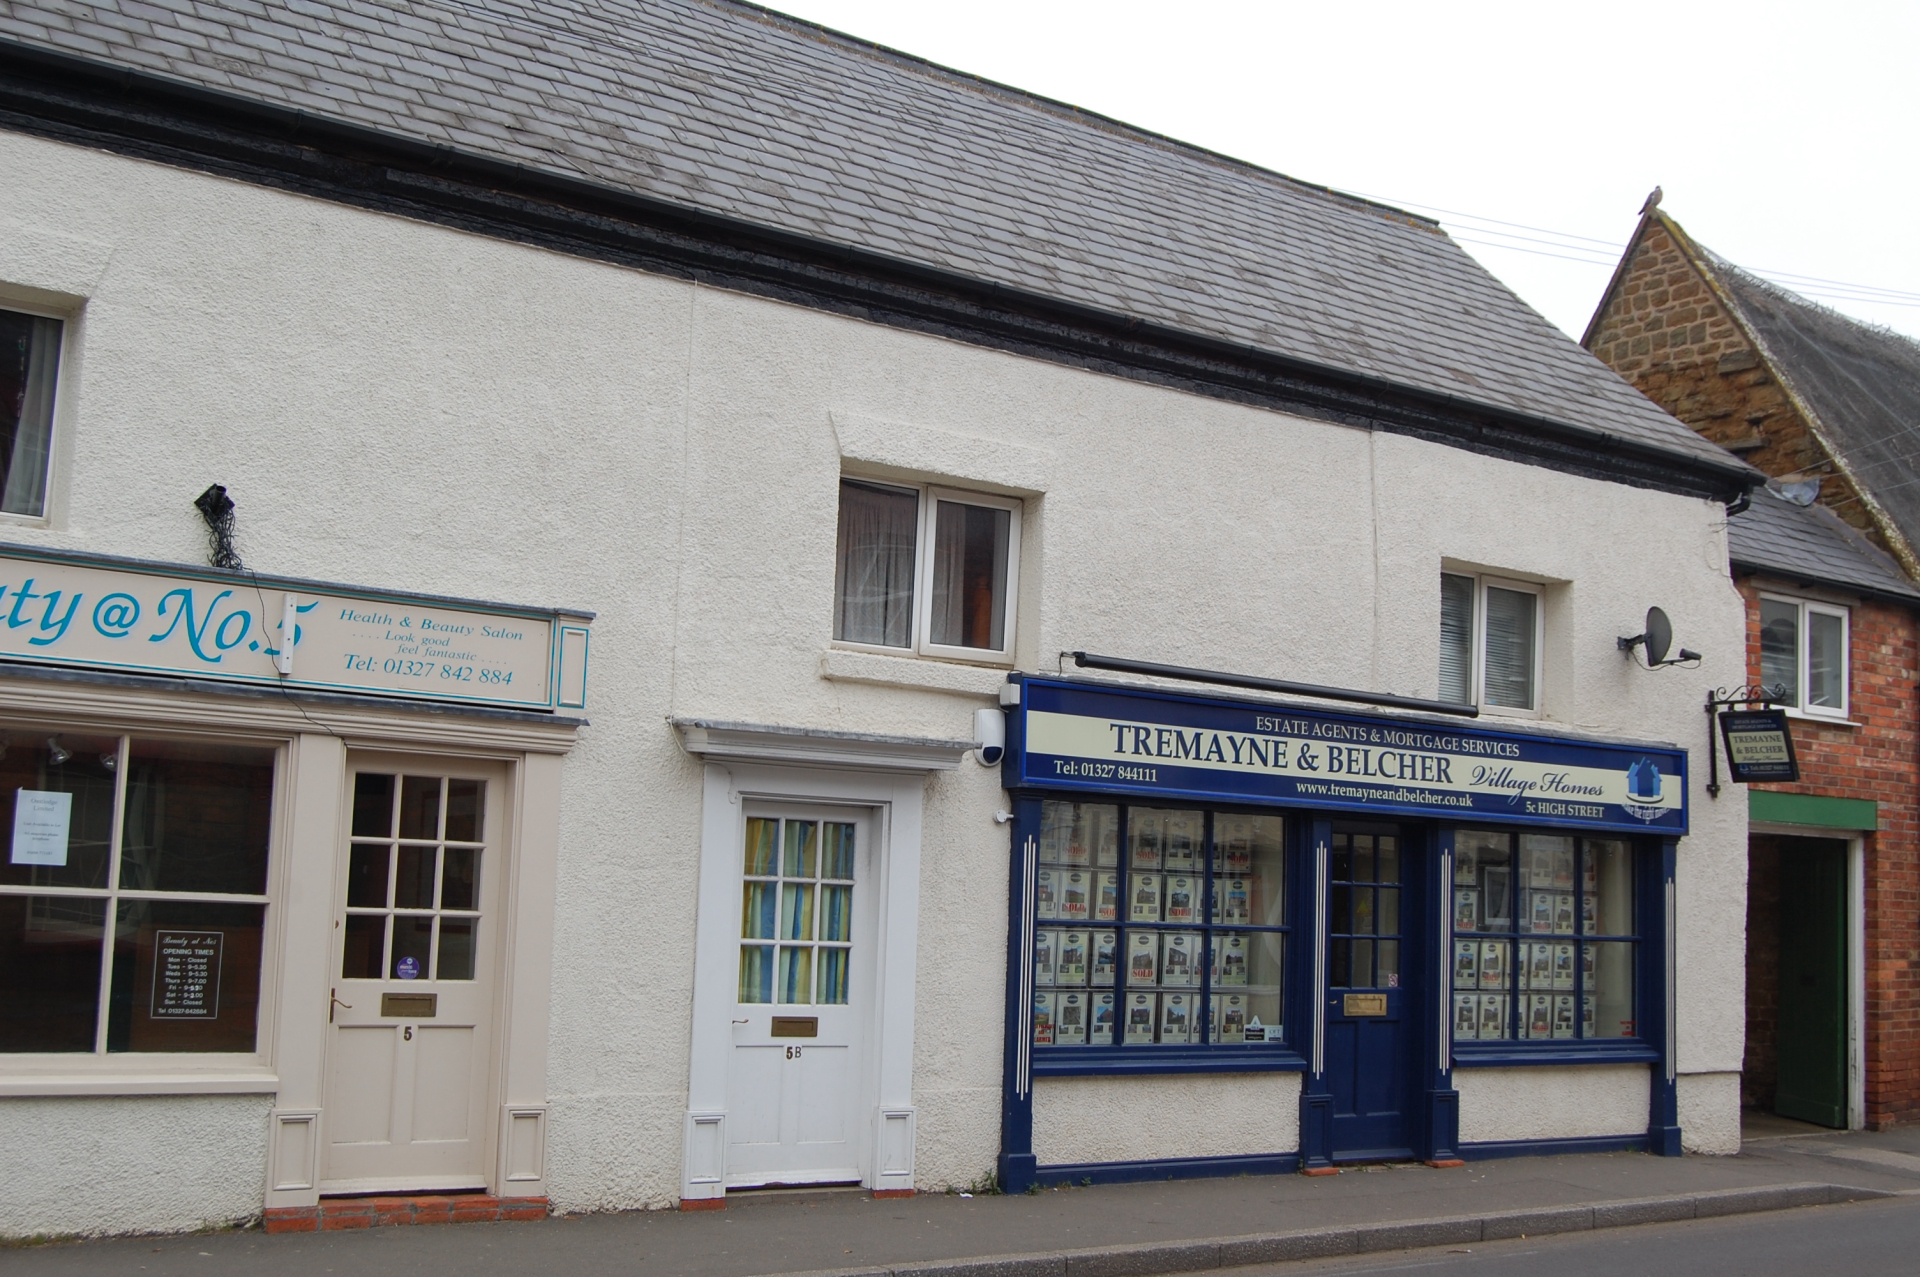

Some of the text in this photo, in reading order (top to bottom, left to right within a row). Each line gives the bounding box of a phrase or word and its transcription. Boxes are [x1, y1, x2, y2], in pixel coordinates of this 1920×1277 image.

[92, 592, 140, 638] @
[339, 609, 523, 641] Health & Beauty Salon
[421, 636, 451, 648] good
[395, 643, 419, 655] feel
[344, 653, 514, 686] Tel: 01327 842 884
[1256, 716, 1520, 757] ESTATE AGENTS & MORTGAGE SERVICES
[1733, 735, 1782, 743] TREMAYNE
[1744, 746, 1784, 754] BELCHER
[1109, 722, 1604, 806] TREMAYNE & BELCHER Village Homes
[1054, 760, 1158, 782] Tel: 01327 844111
[1296, 783, 1473, 807] www.tremayneandbelcher.co.uk
[1526, 801, 1604, 818] 5c HIGH STREET
[1137, 850, 1159, 860] SOLD
[1064, 902, 1086, 913] SOLD
[1101, 907, 1116, 917] SOL
[162, 935, 188, 947] Beauty
[191, 937, 200, 945] at
[1132, 968, 1154, 978] SOLD
[404, 1026, 412, 1041] 5
